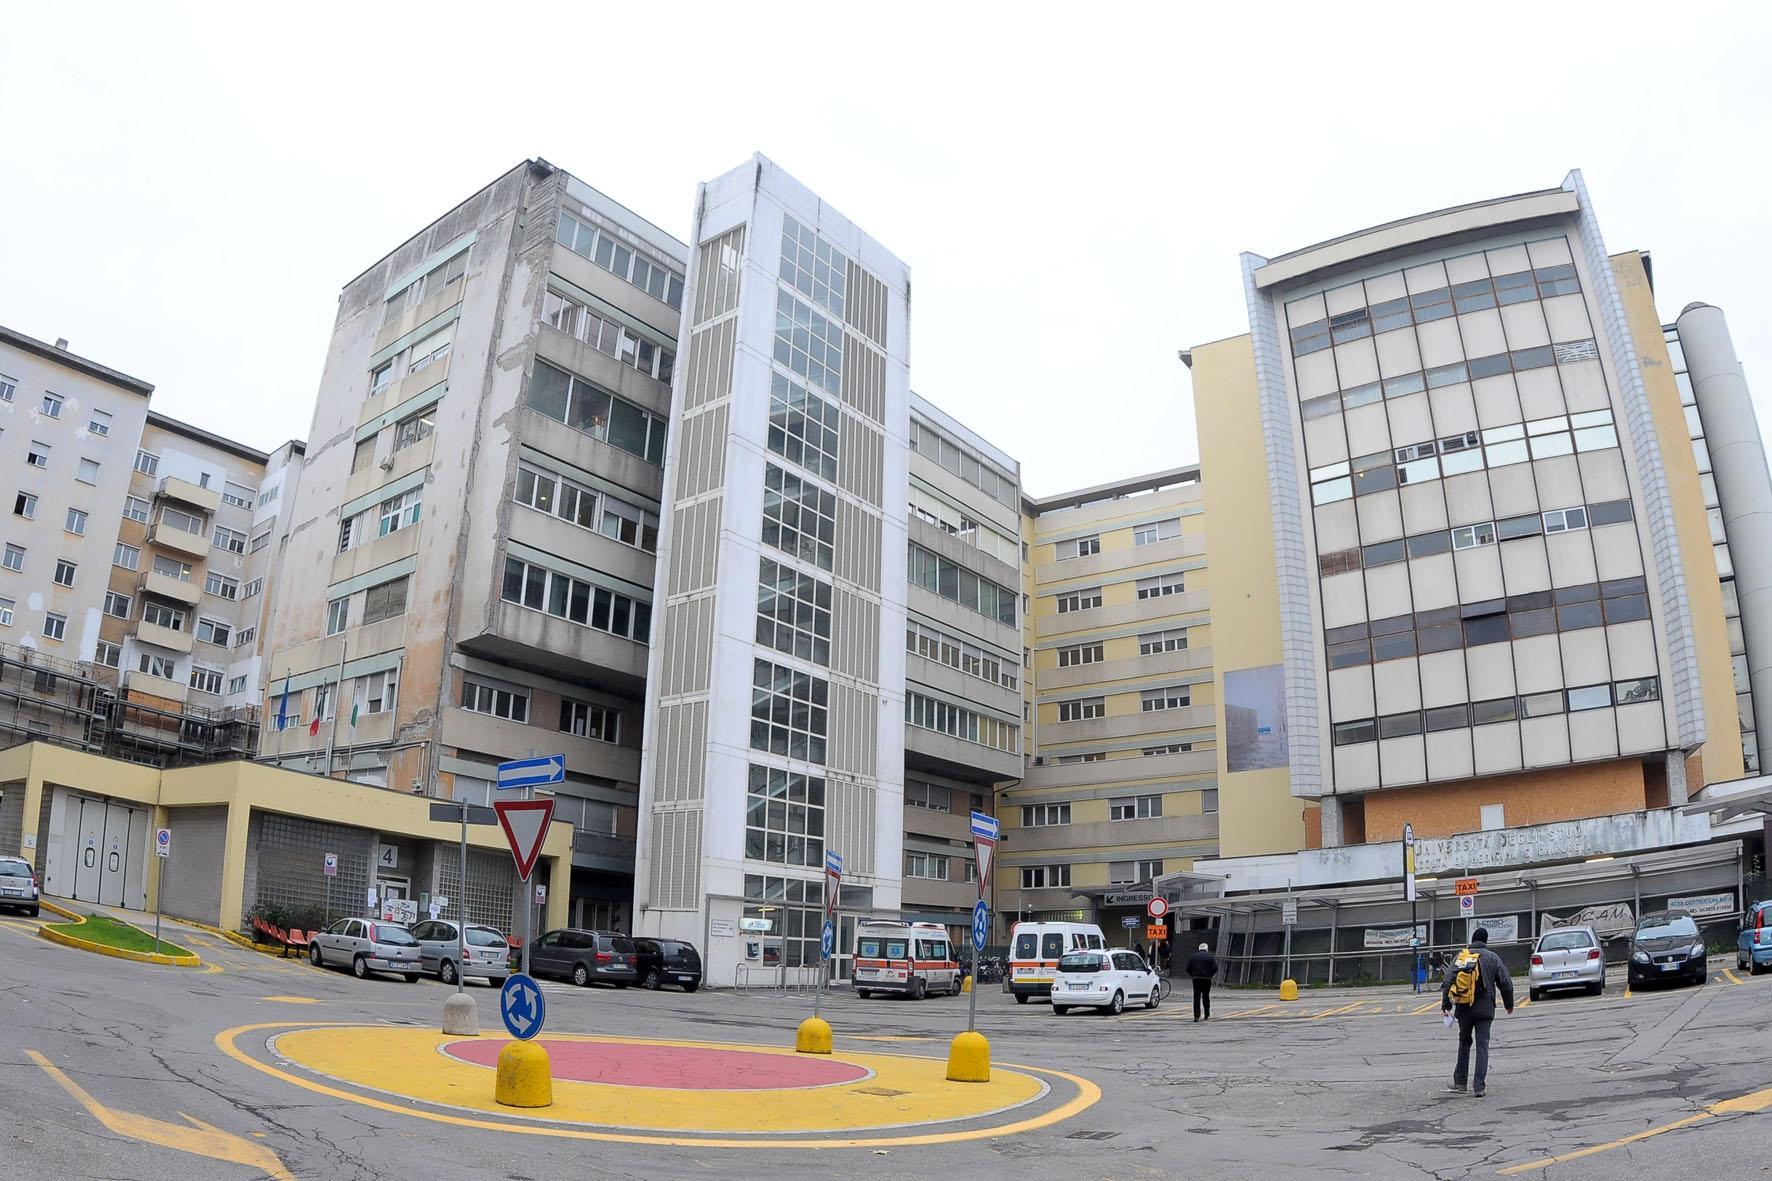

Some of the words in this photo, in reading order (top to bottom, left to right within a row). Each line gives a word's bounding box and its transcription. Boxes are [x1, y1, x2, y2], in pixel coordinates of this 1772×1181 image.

[382, 848, 392, 864] 4
[1457, 883, 1476, 891] TAXI
[1148, 928, 1166, 936] TAXI
